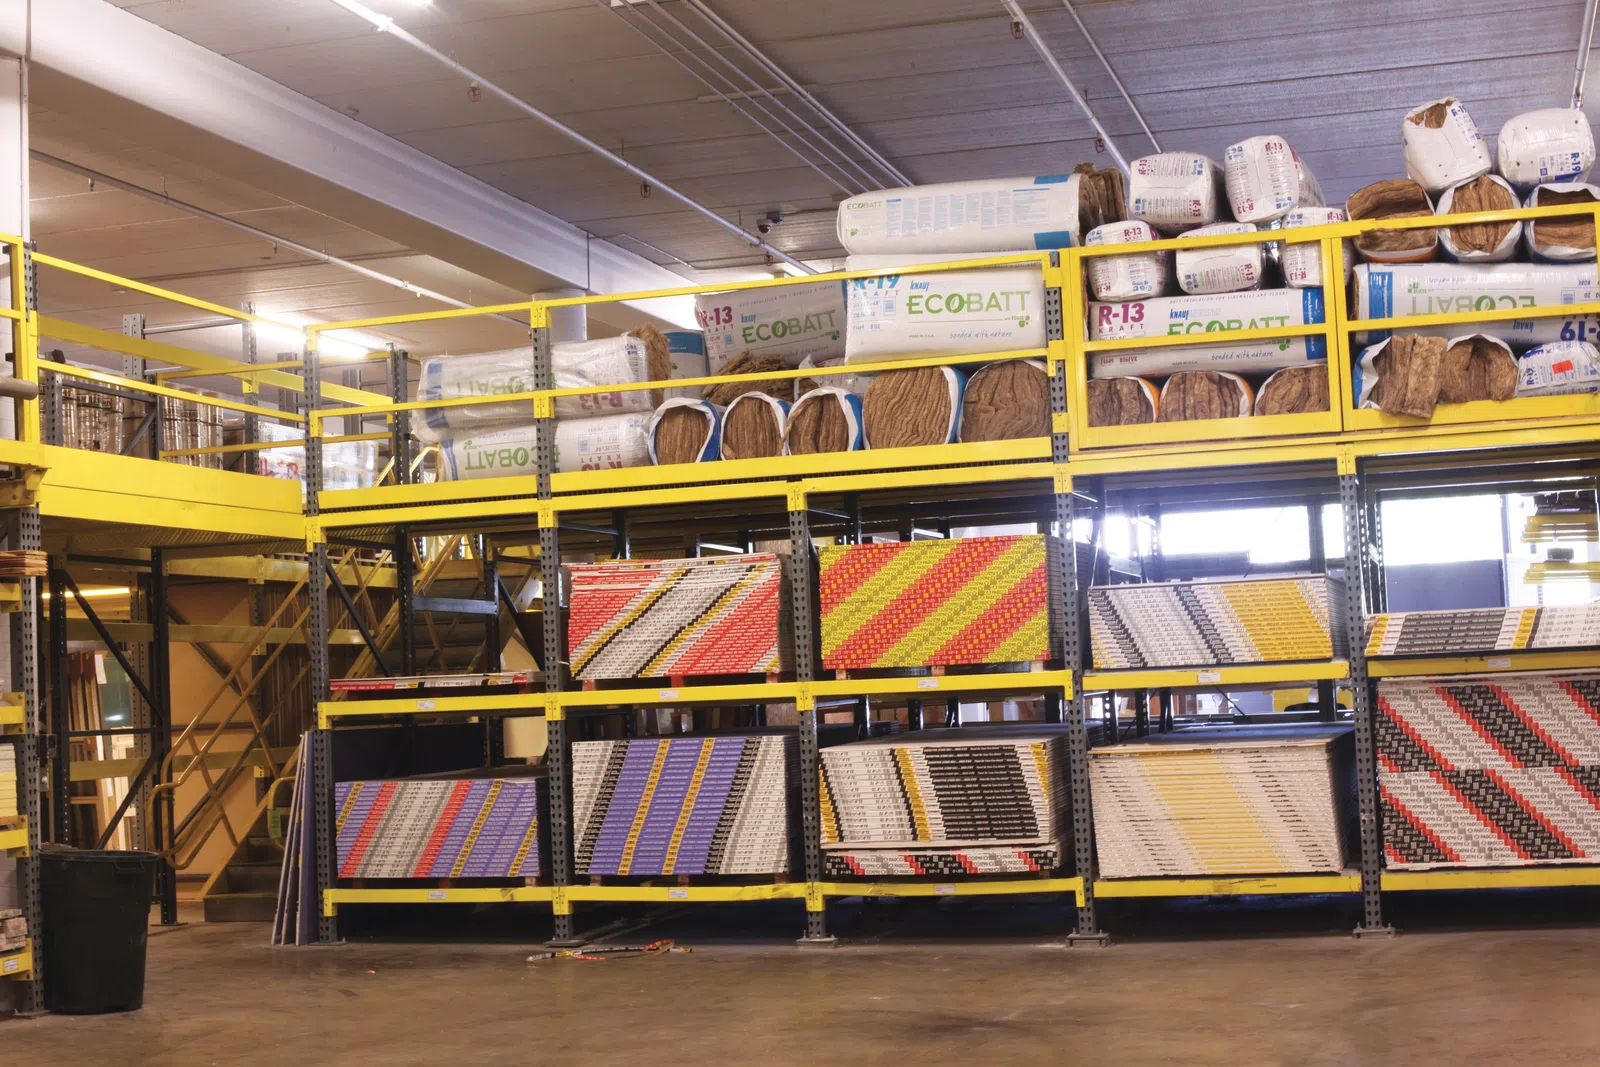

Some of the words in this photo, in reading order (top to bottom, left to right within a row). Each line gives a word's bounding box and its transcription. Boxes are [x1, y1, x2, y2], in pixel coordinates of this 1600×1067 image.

[1265, 142, 1283, 152] R-13
[1138, 159, 1148, 175] R-13
[1570, 152, 1582, 172] R-19
[846, 201, 882, 210] ECOBATT
[1192, 200, 1201, 216] R-13
[1236, 202, 1254, 215] R-13
[1123, 227, 1143, 237] R-13
[1243, 263, 1255, 281] R-13
[1289, 270, 1307, 280] R-13
[853, 290, 899, 299] KRAFT
[906, 291, 1031, 315] ECOBATT
[1098, 303, 1145, 327] R-13
[741, 309, 836, 344] ECOBATT
[1099, 323, 1145, 334] KRAFT
[1560, 321, 1600, 342] -19
[1526, 367, 1535, 386] R-19
[581, 453, 622, 464] KRAFT
